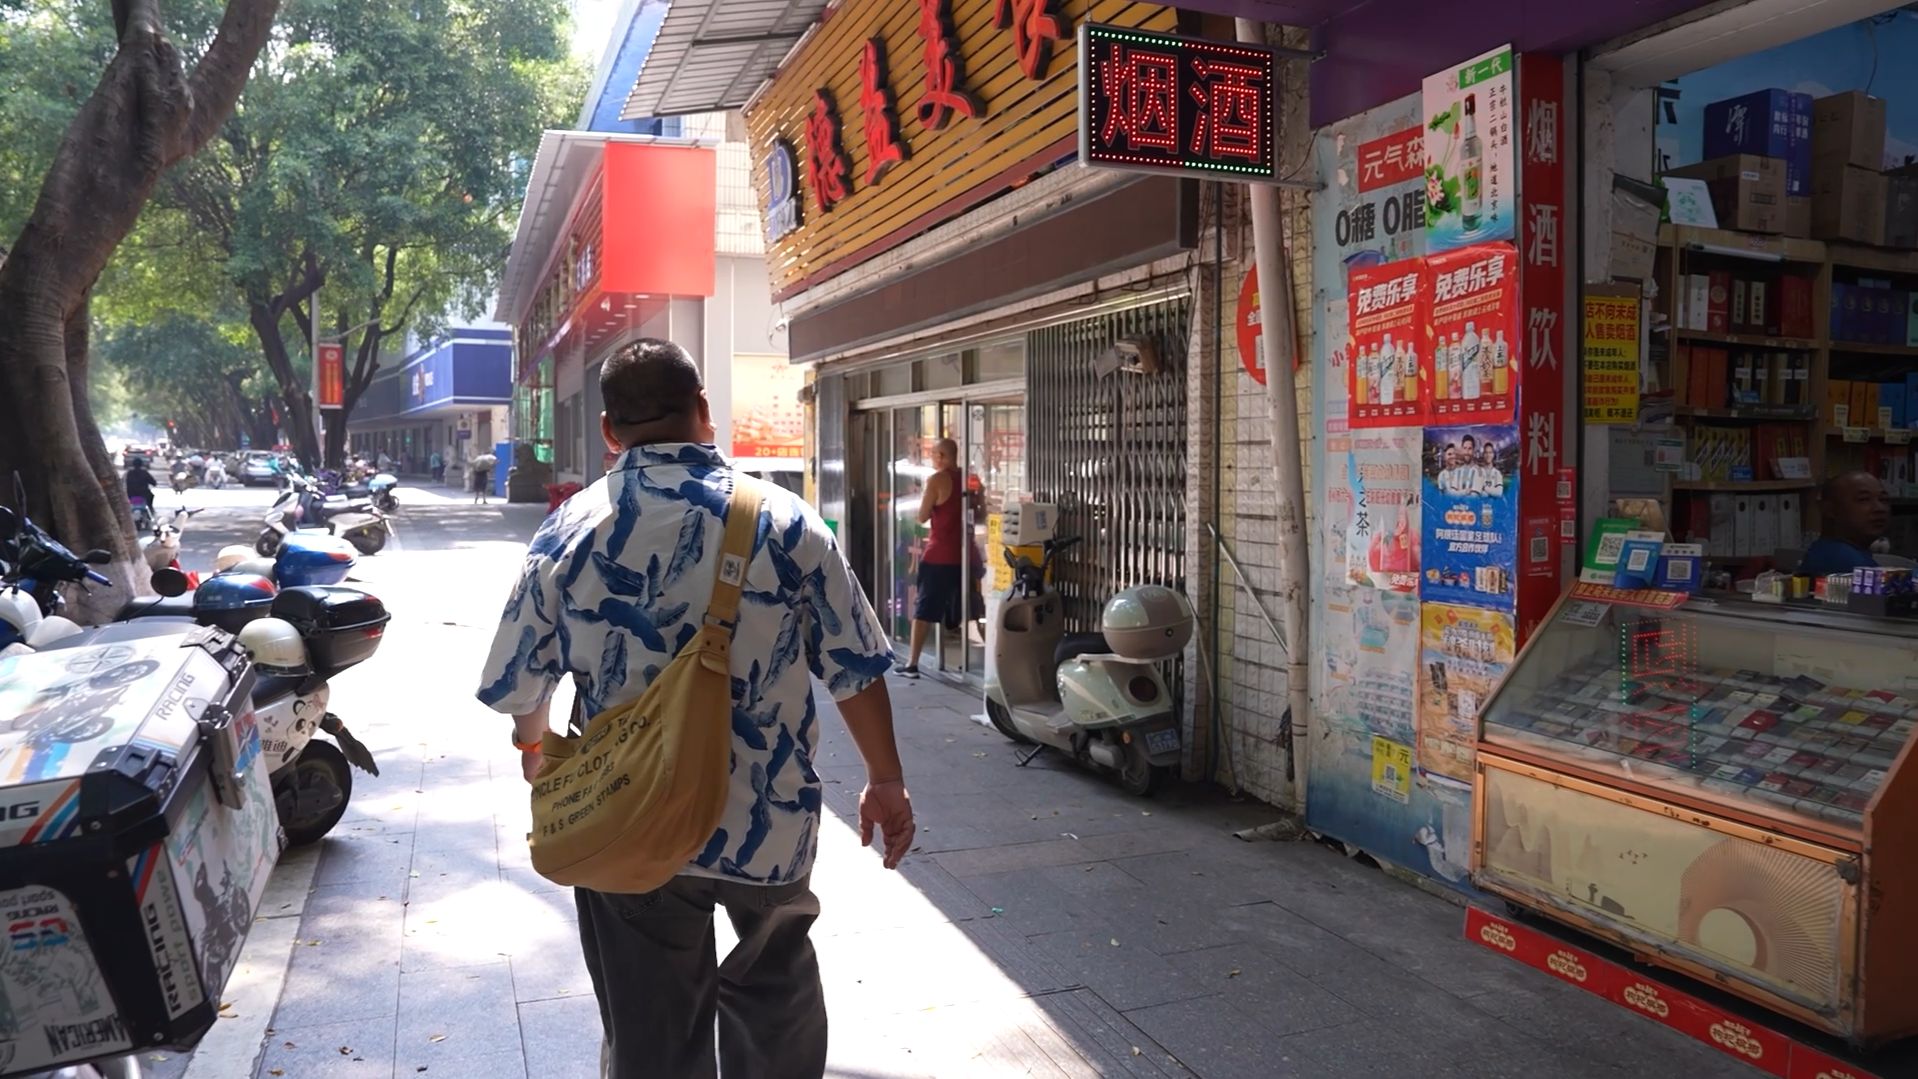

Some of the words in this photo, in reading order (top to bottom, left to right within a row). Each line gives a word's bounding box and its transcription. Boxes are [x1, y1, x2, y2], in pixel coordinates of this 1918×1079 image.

[1464, 59, 1503, 84] 新一代
[1102, 43, 1262, 163] 烟酒
[1335, 201, 1376, 247] 0糖
[1383, 189, 1425, 235] 0脂
[1357, 272, 1419, 315] 免费乐享
[1433, 254, 1506, 303] 免费乐享
[1527, 98, 1558, 476] 烟酒饮料
[155, 672, 196, 721] RACING
[534, 777, 562, 800] NCLE
[568, 802, 594, 824] GREEN
[596, 774, 630, 806] STAMPS
[143, 903, 182, 1013] RACING
[43, 1012, 127, 1057] AMERICAN
